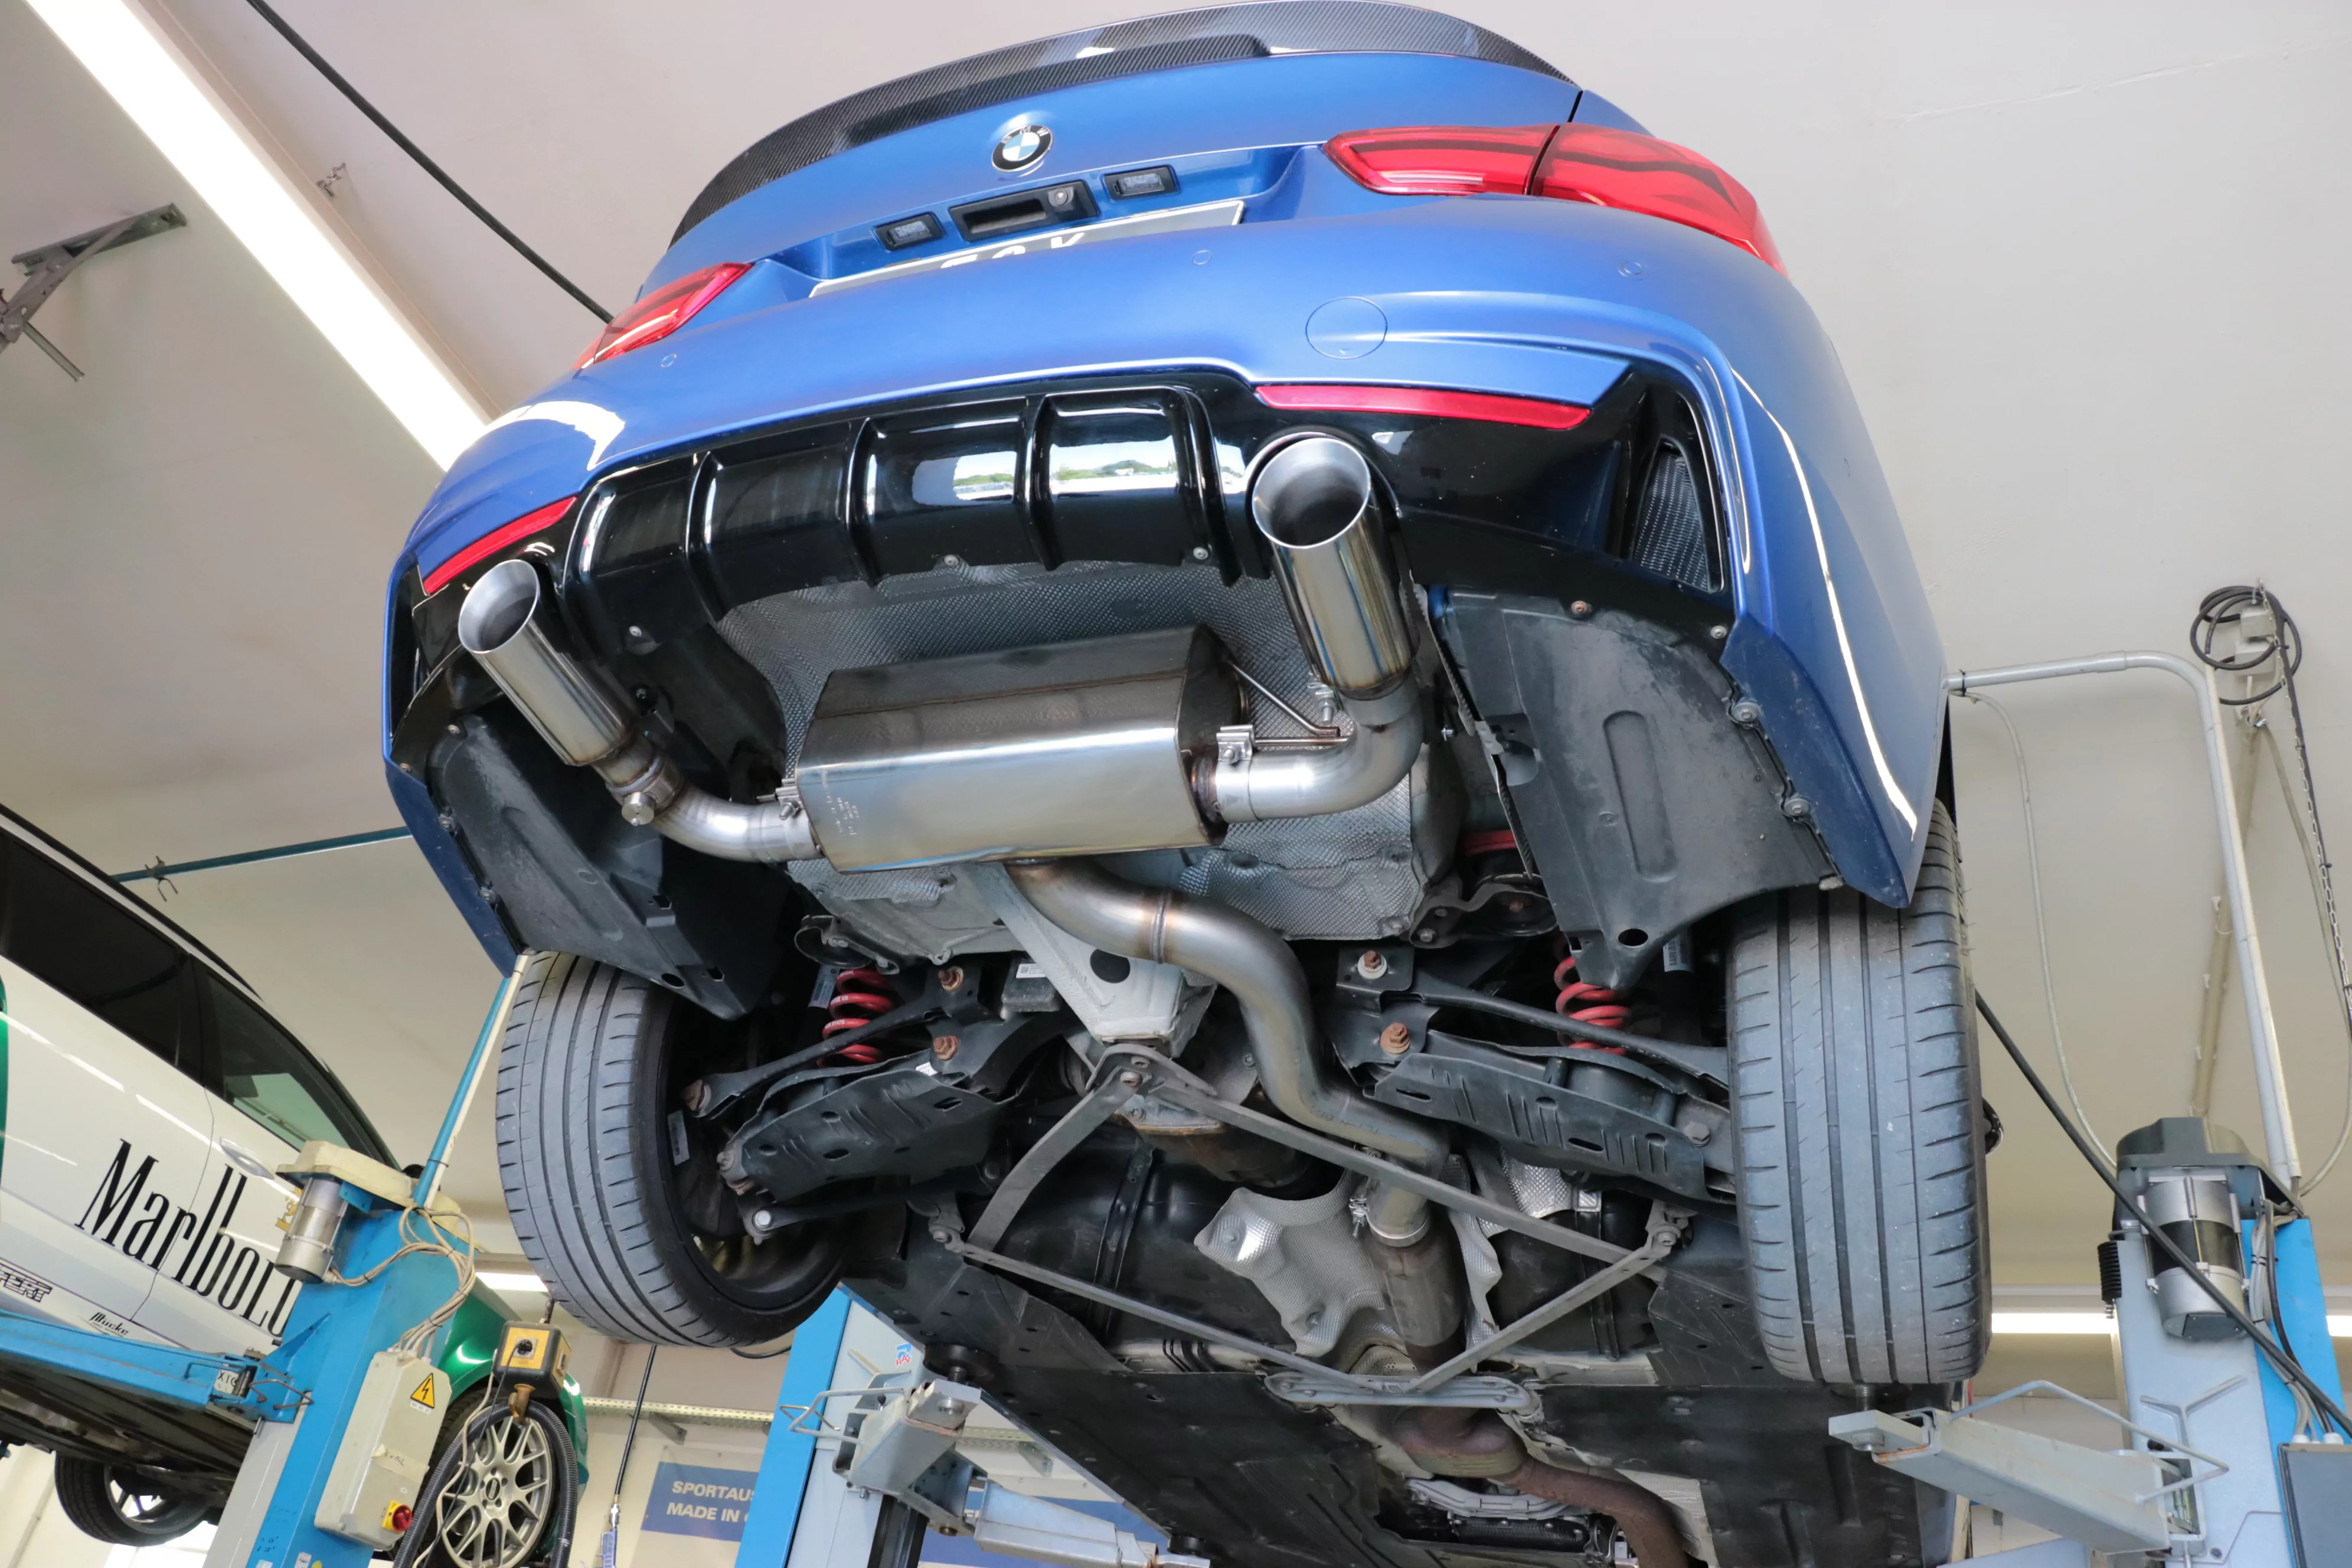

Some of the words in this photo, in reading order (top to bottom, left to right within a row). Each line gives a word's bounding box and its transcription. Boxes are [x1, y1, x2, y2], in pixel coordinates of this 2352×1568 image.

[1000, 126, 1050, 144] BMW
[896, 1355, 910, 1366] RAV
[667, 1502, 718, 1520] MADE
[721, 1508, 740, 1523] IN
